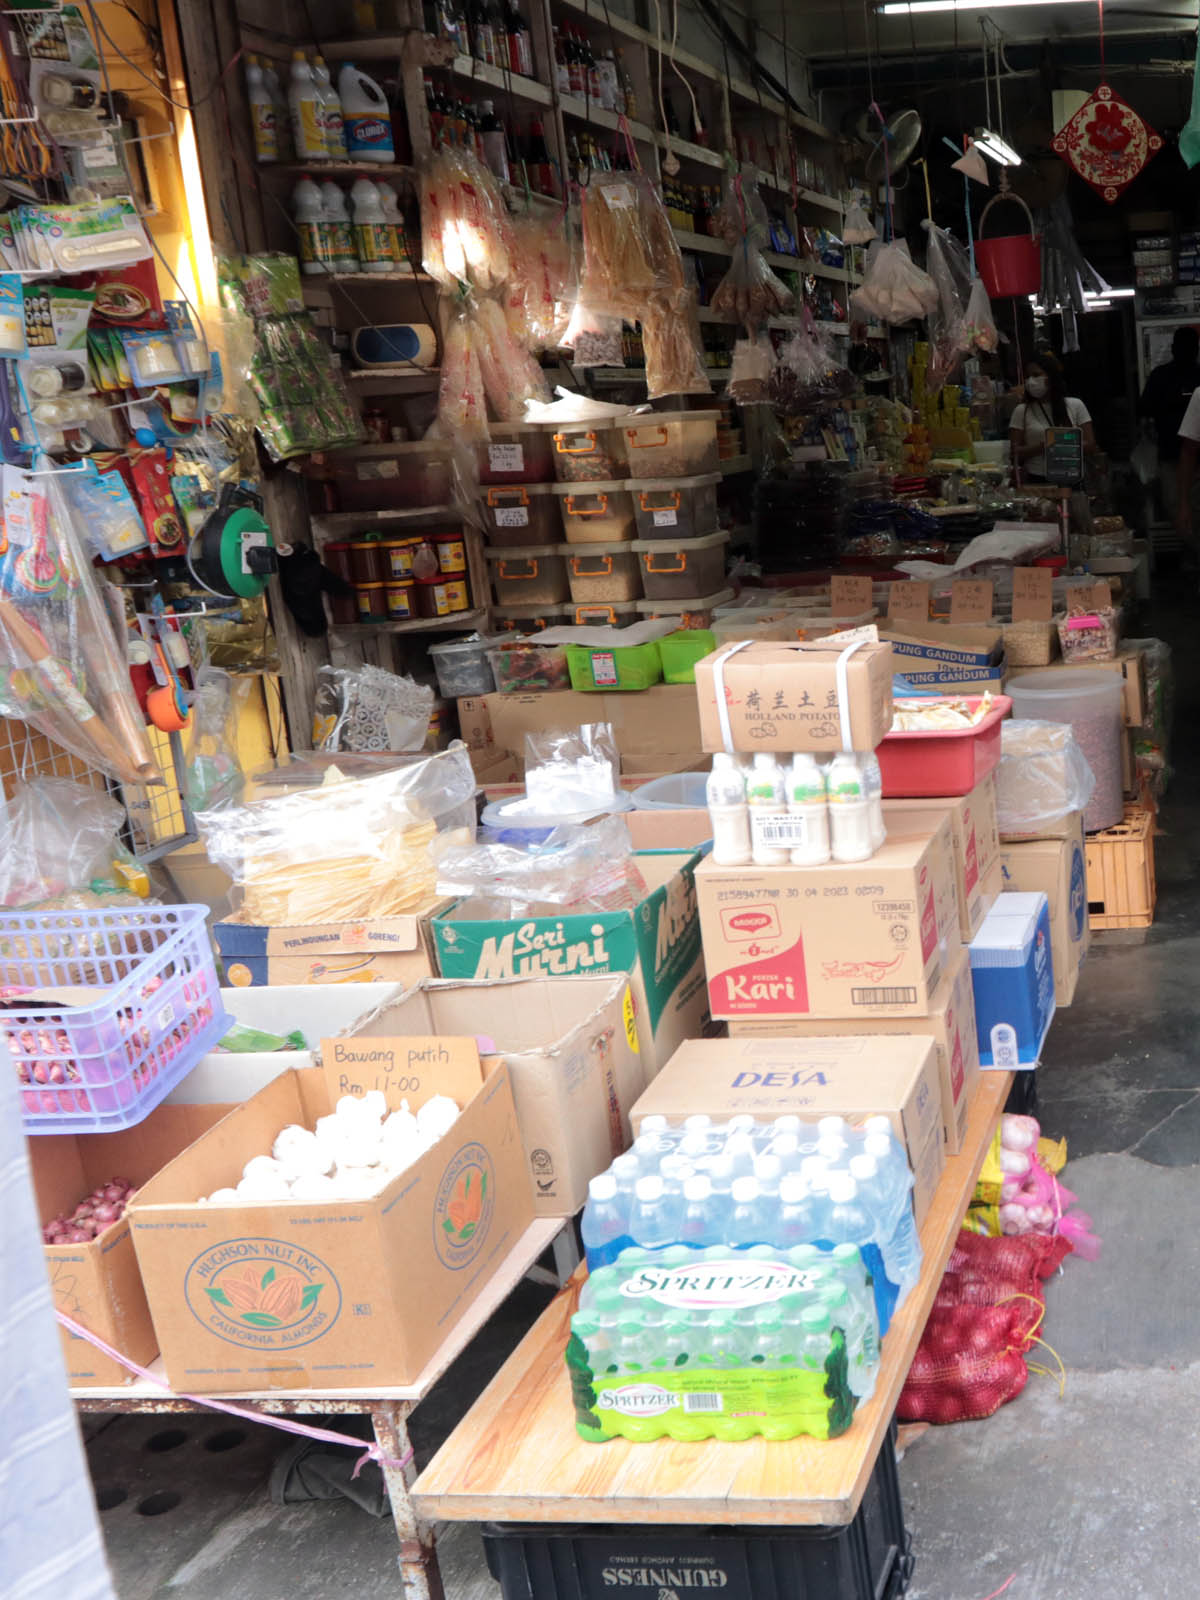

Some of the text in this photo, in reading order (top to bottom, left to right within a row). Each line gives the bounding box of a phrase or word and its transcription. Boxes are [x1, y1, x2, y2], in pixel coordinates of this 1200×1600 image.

[926, 648, 977, 664] GANDUM
[939, 670, 990, 682] GANDUM
[746, 689, 840, 711] 荷兰土豆
[744, 712, 796, 721] HOLLAND
[513, 922, 565, 948] Seri
[475, 924, 610, 978] Murni
[725, 975, 795, 1001] Kari
[334, 1043, 449, 1072] Bawang putih
[731, 1069, 832, 1089] DESA
[196, 1243, 322, 1279] HUGHSON NUT INC
[626, 1271, 808, 1294] SPRITZER
[209, 1310, 329, 1345] CALIFORNIA ALMONDS
[600, 1390, 677, 1407] SPRITZER
[602, 1567, 728, 1588] GUINNESS
